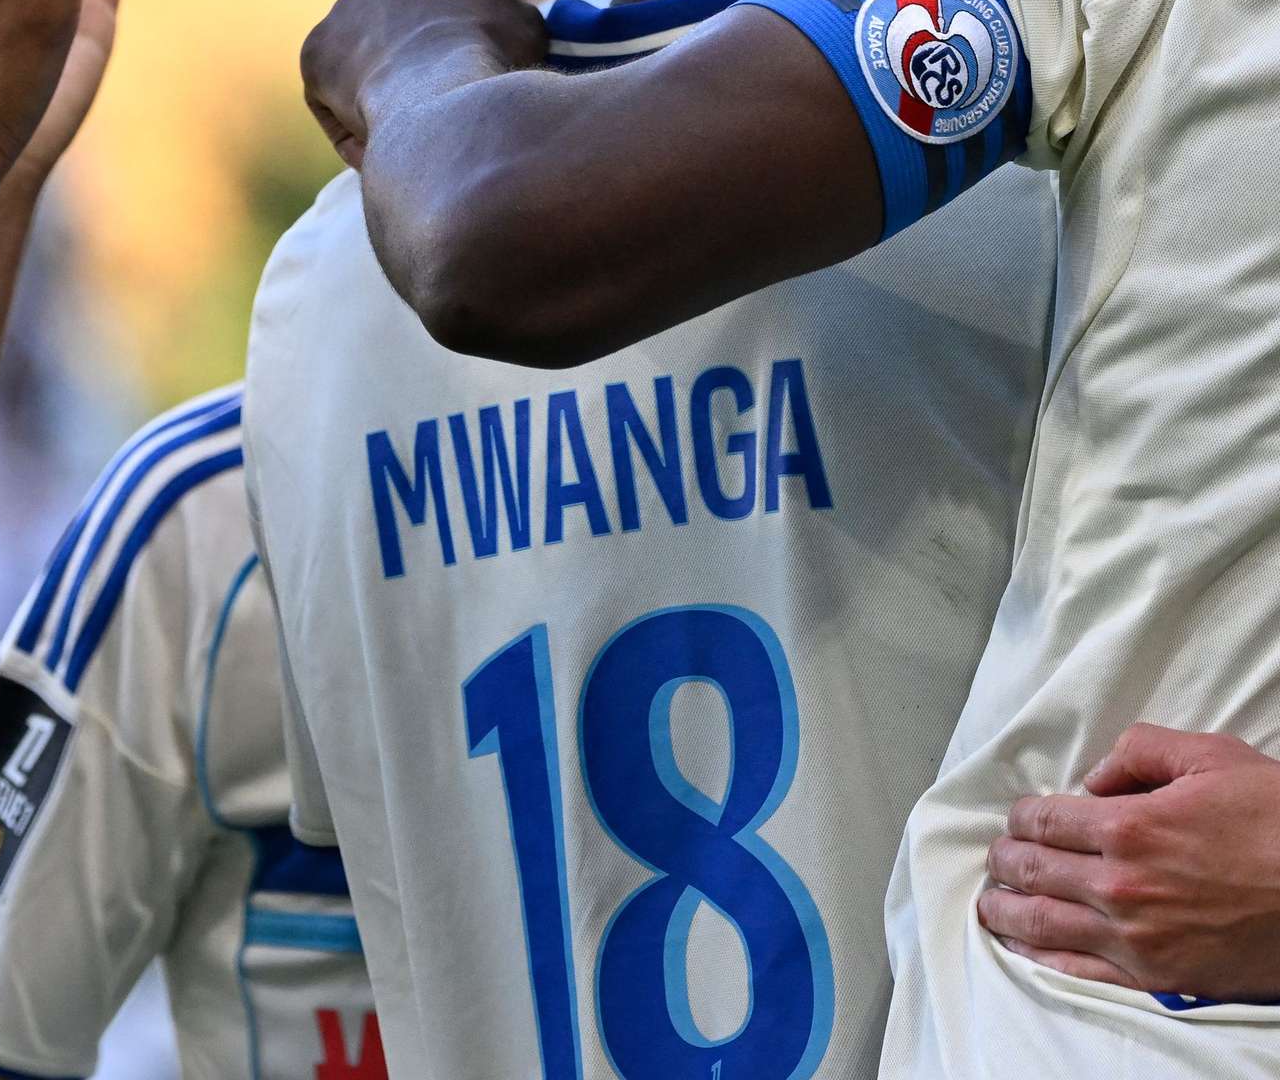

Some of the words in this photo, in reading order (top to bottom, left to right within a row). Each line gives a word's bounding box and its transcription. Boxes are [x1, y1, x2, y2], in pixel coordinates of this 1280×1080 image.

[868, 14, 891, 70] ALSACE
[989, 19, 1010, 56] CLUB
[997, 58, 1010, 79] DE
[934, 78, 1004, 133] STRASBOURG
[365, 358, 834, 580] MWANGA
[461, 603, 836, 1080] 18
